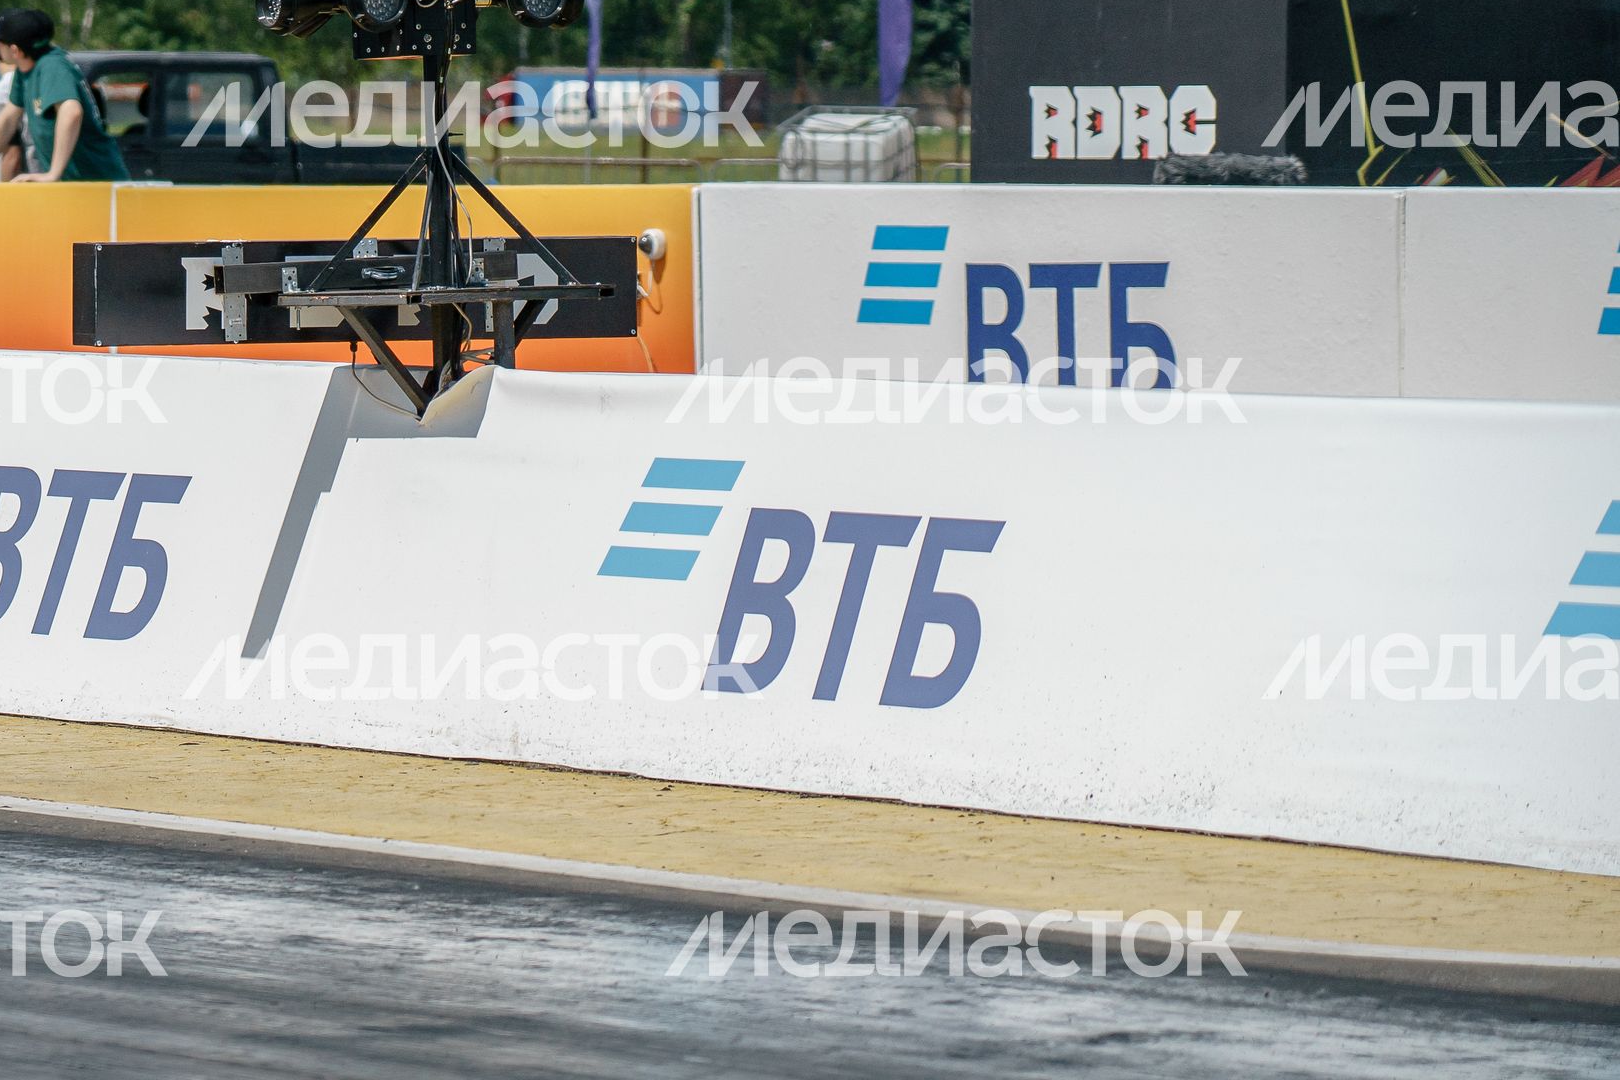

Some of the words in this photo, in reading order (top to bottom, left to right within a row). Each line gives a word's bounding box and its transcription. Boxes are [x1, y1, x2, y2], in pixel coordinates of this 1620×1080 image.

[1029, 85, 1217, 160] RDRC
[964, 260, 1178, 390] ВТБ
[700, 507, 1007, 709] ВТБ
